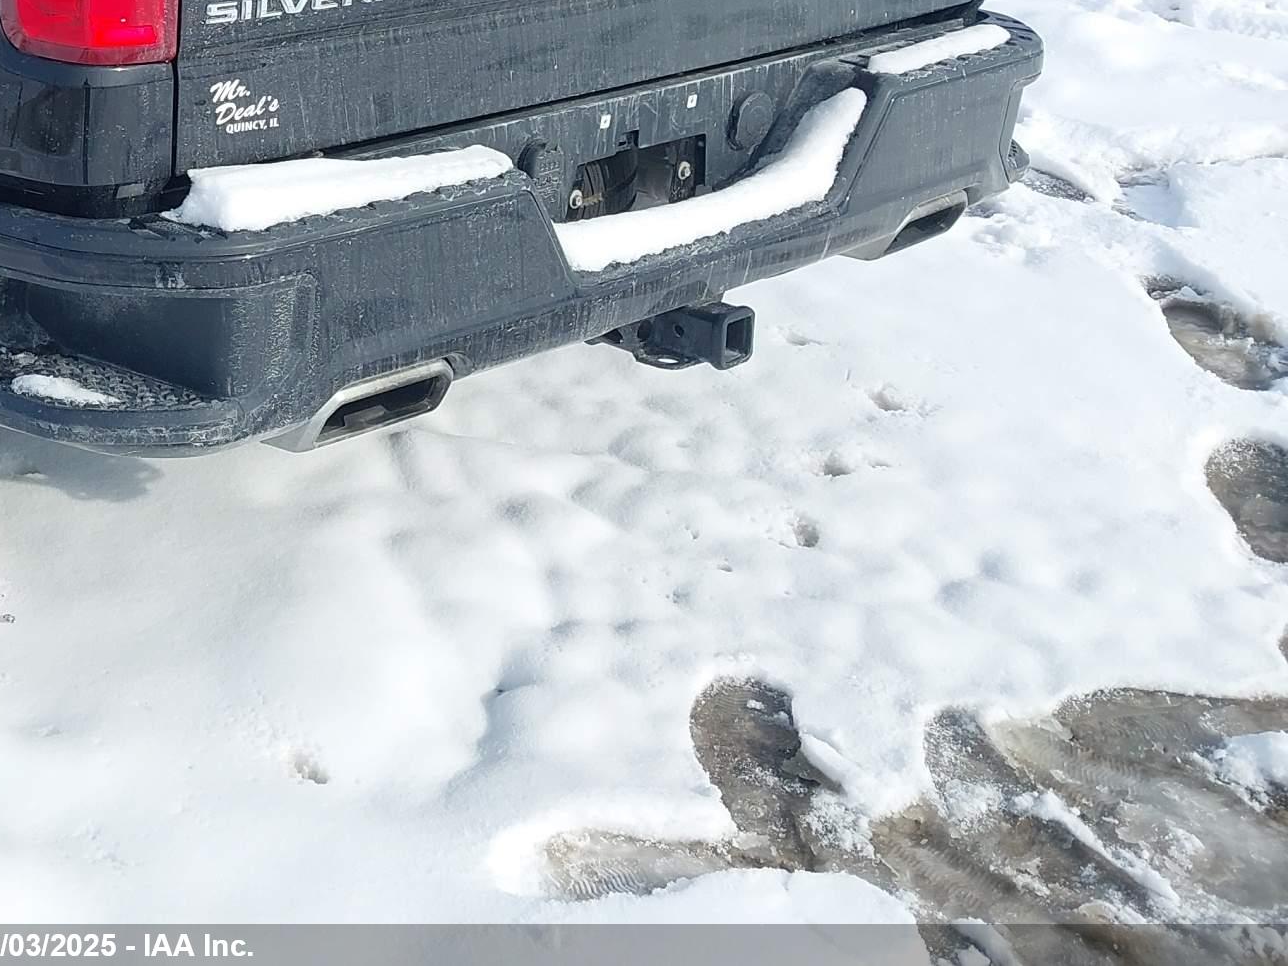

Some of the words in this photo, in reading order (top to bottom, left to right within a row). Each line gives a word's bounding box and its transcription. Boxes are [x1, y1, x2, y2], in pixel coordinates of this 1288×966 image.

[209, 79, 251, 103] Mr.
[215, 96, 279, 125] Deal's
[226, 120, 267, 134] QUINCY,
[269, 118, 279, 127] IL
